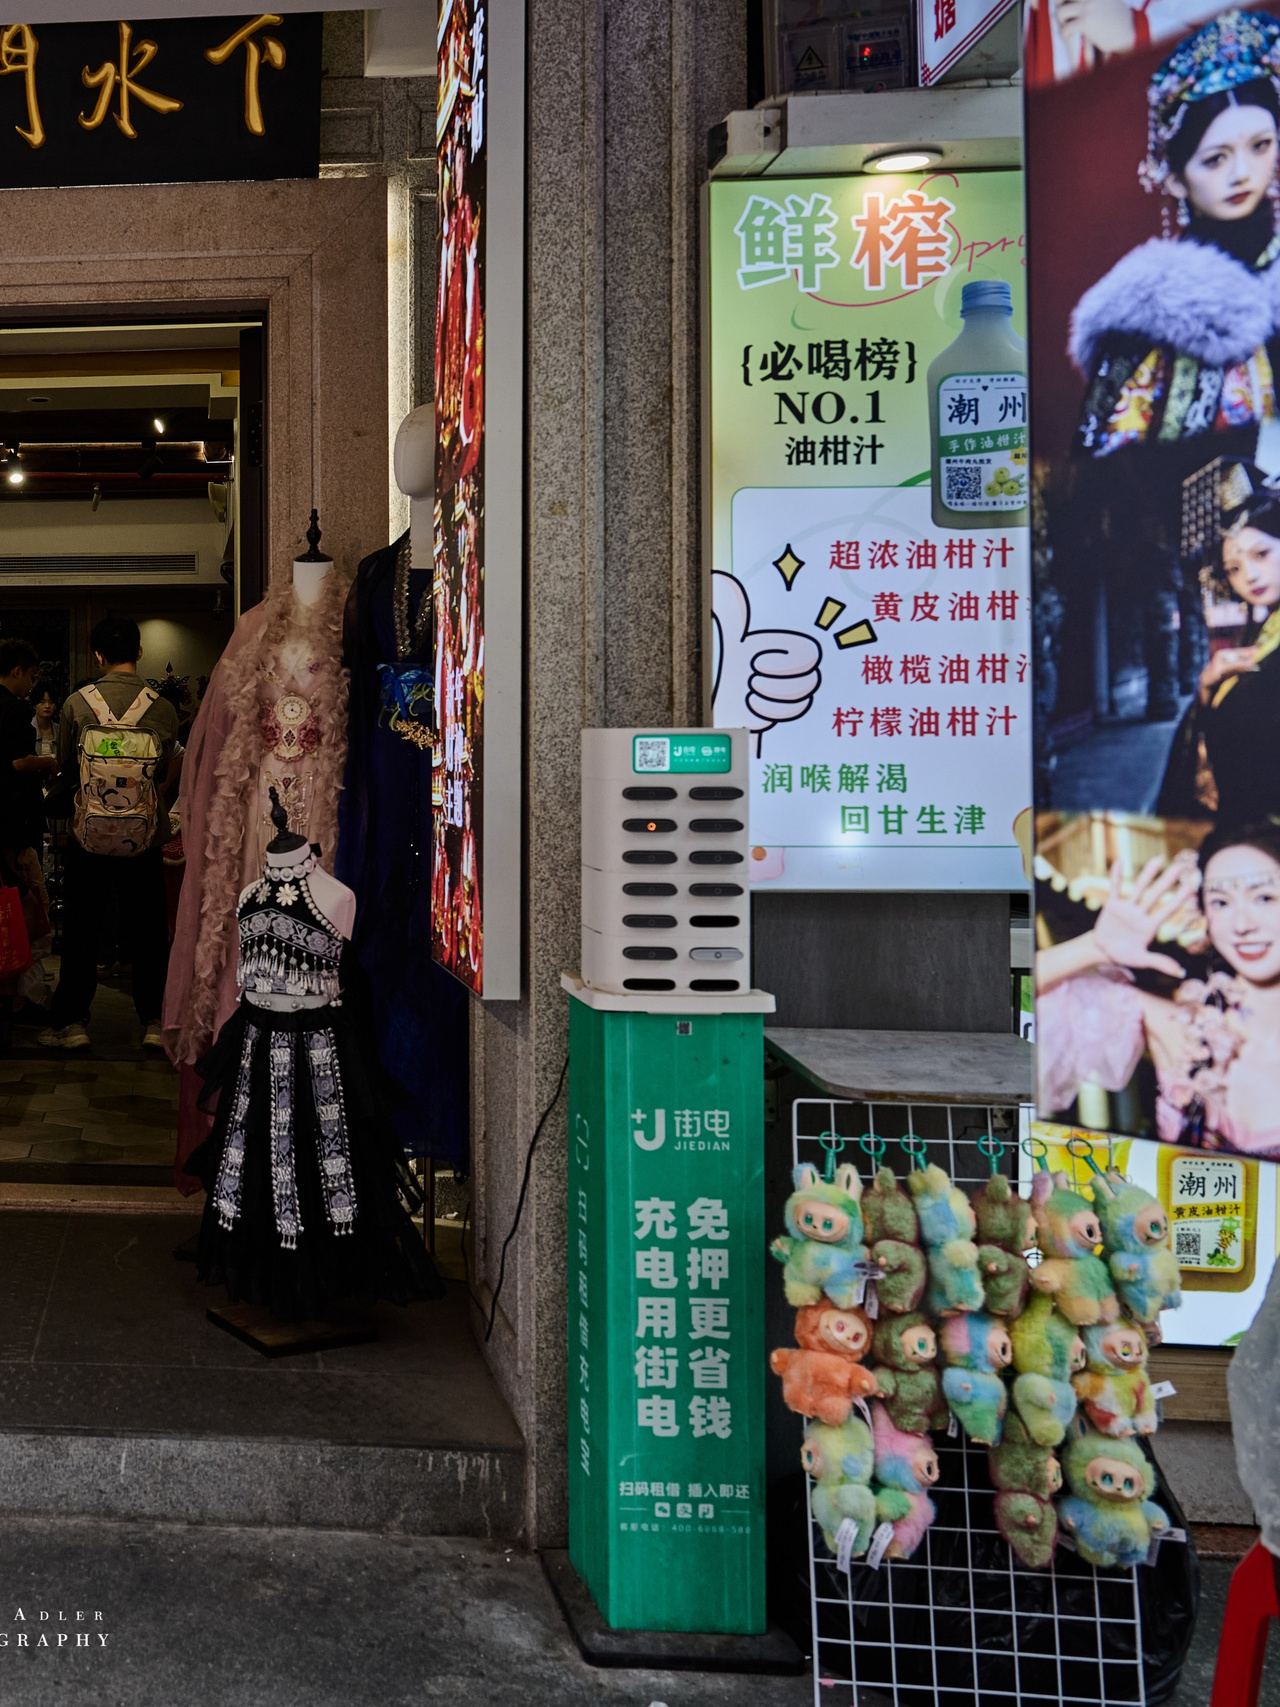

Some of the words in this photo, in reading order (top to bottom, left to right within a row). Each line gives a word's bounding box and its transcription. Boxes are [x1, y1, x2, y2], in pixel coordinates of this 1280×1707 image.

[735, 193, 954, 291] 鲜榨
[774, 389, 886, 425] NO.1
[785, 434, 885, 466] 油柑汁
[829, 538, 1015, 570] 超浓油柑汁
[871, 590, 1031, 623] 黄皮油柑
[831, 705, 1018, 737] 柠檬油柑汁
[761, 763, 908, 794] 润喉解渴
[840, 805, 987, 835] 回甘生津
[673, 1109, 730, 1138] 街电
[674, 1141, 730, 1151] JIEDIAN
[1179, 1172, 1237, 1199] 潮州
[1173, 1204, 1241, 1218] 黄皮油柑汁
[633, 1197, 680, 1437] 充电用街电
[686, 1197, 733, 1439] 免押更省钱
[619, 1481, 680, 1497] 扫码租借
[688, 1483, 750, 1499] 插入即还
